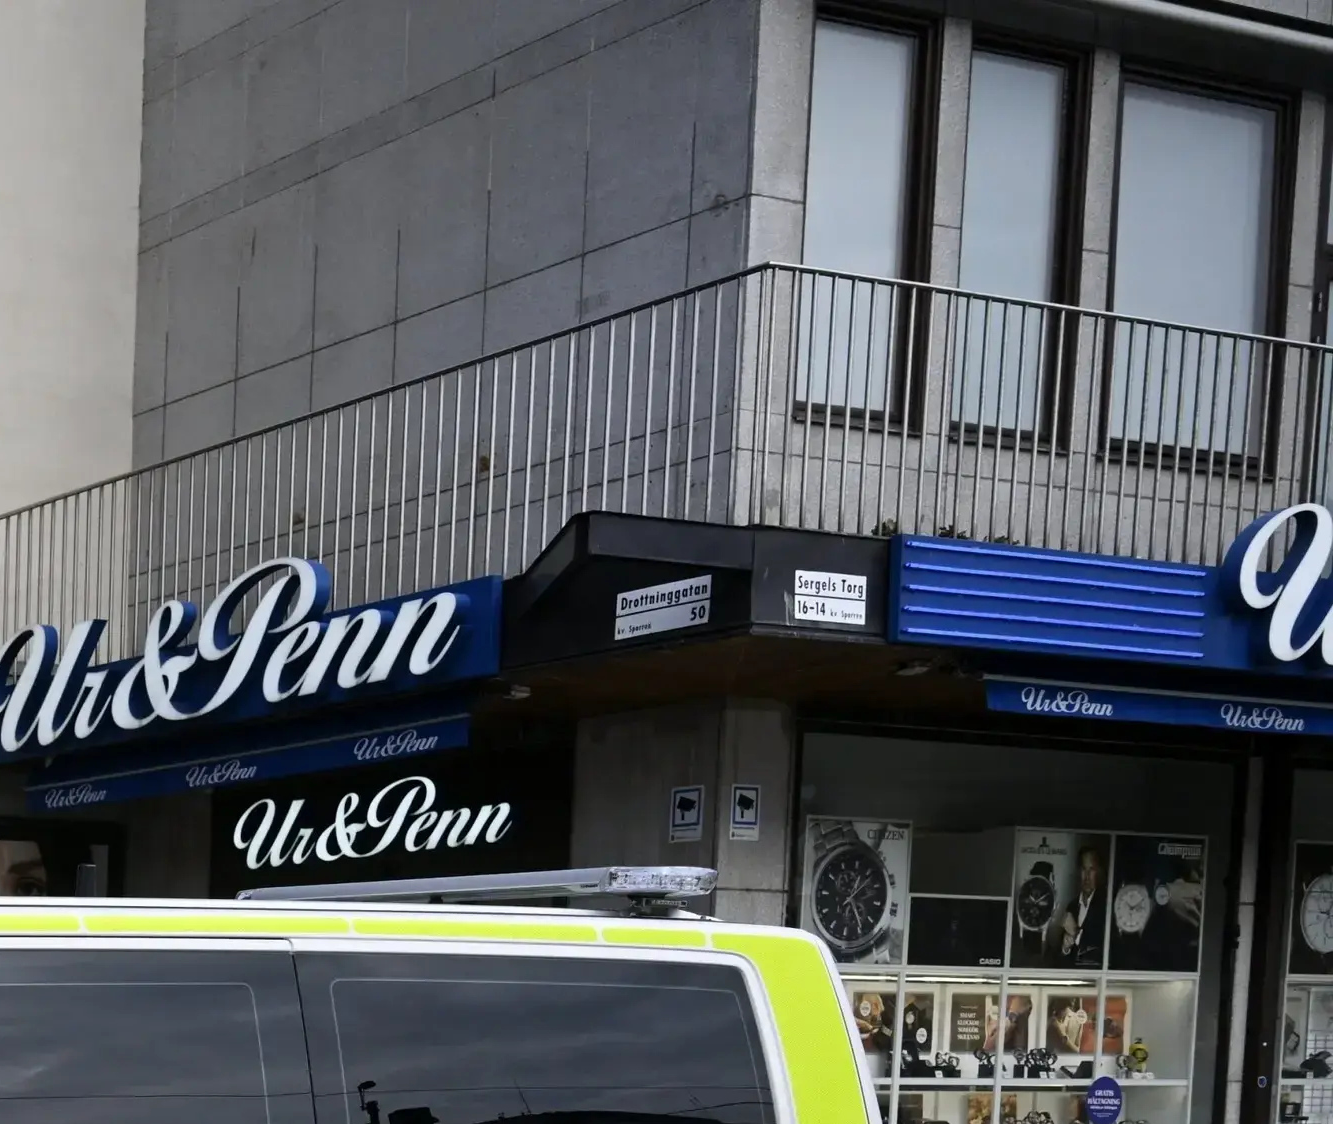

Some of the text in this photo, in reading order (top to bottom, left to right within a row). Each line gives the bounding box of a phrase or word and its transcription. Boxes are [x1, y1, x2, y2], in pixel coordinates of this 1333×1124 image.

[620, 583, 708, 611] Drottninggatan
[798, 575, 864, 598] Sergels Torg
[689, 605, 706, 621] 50
[797, 600, 826, 616] 16-14
[1021, 686, 1114, 717] Ur&Penn
[1220, 703, 1305, 732] Ur&Penn
[352, 729, 439, 761] Ur&Penn
[185, 758, 258, 787] Ur&Penn
[44, 784, 107, 809] Ur&Penn
[233, 775, 513, 871] Ur&Penn
[867, 829, 905, 841] CIIZEN
